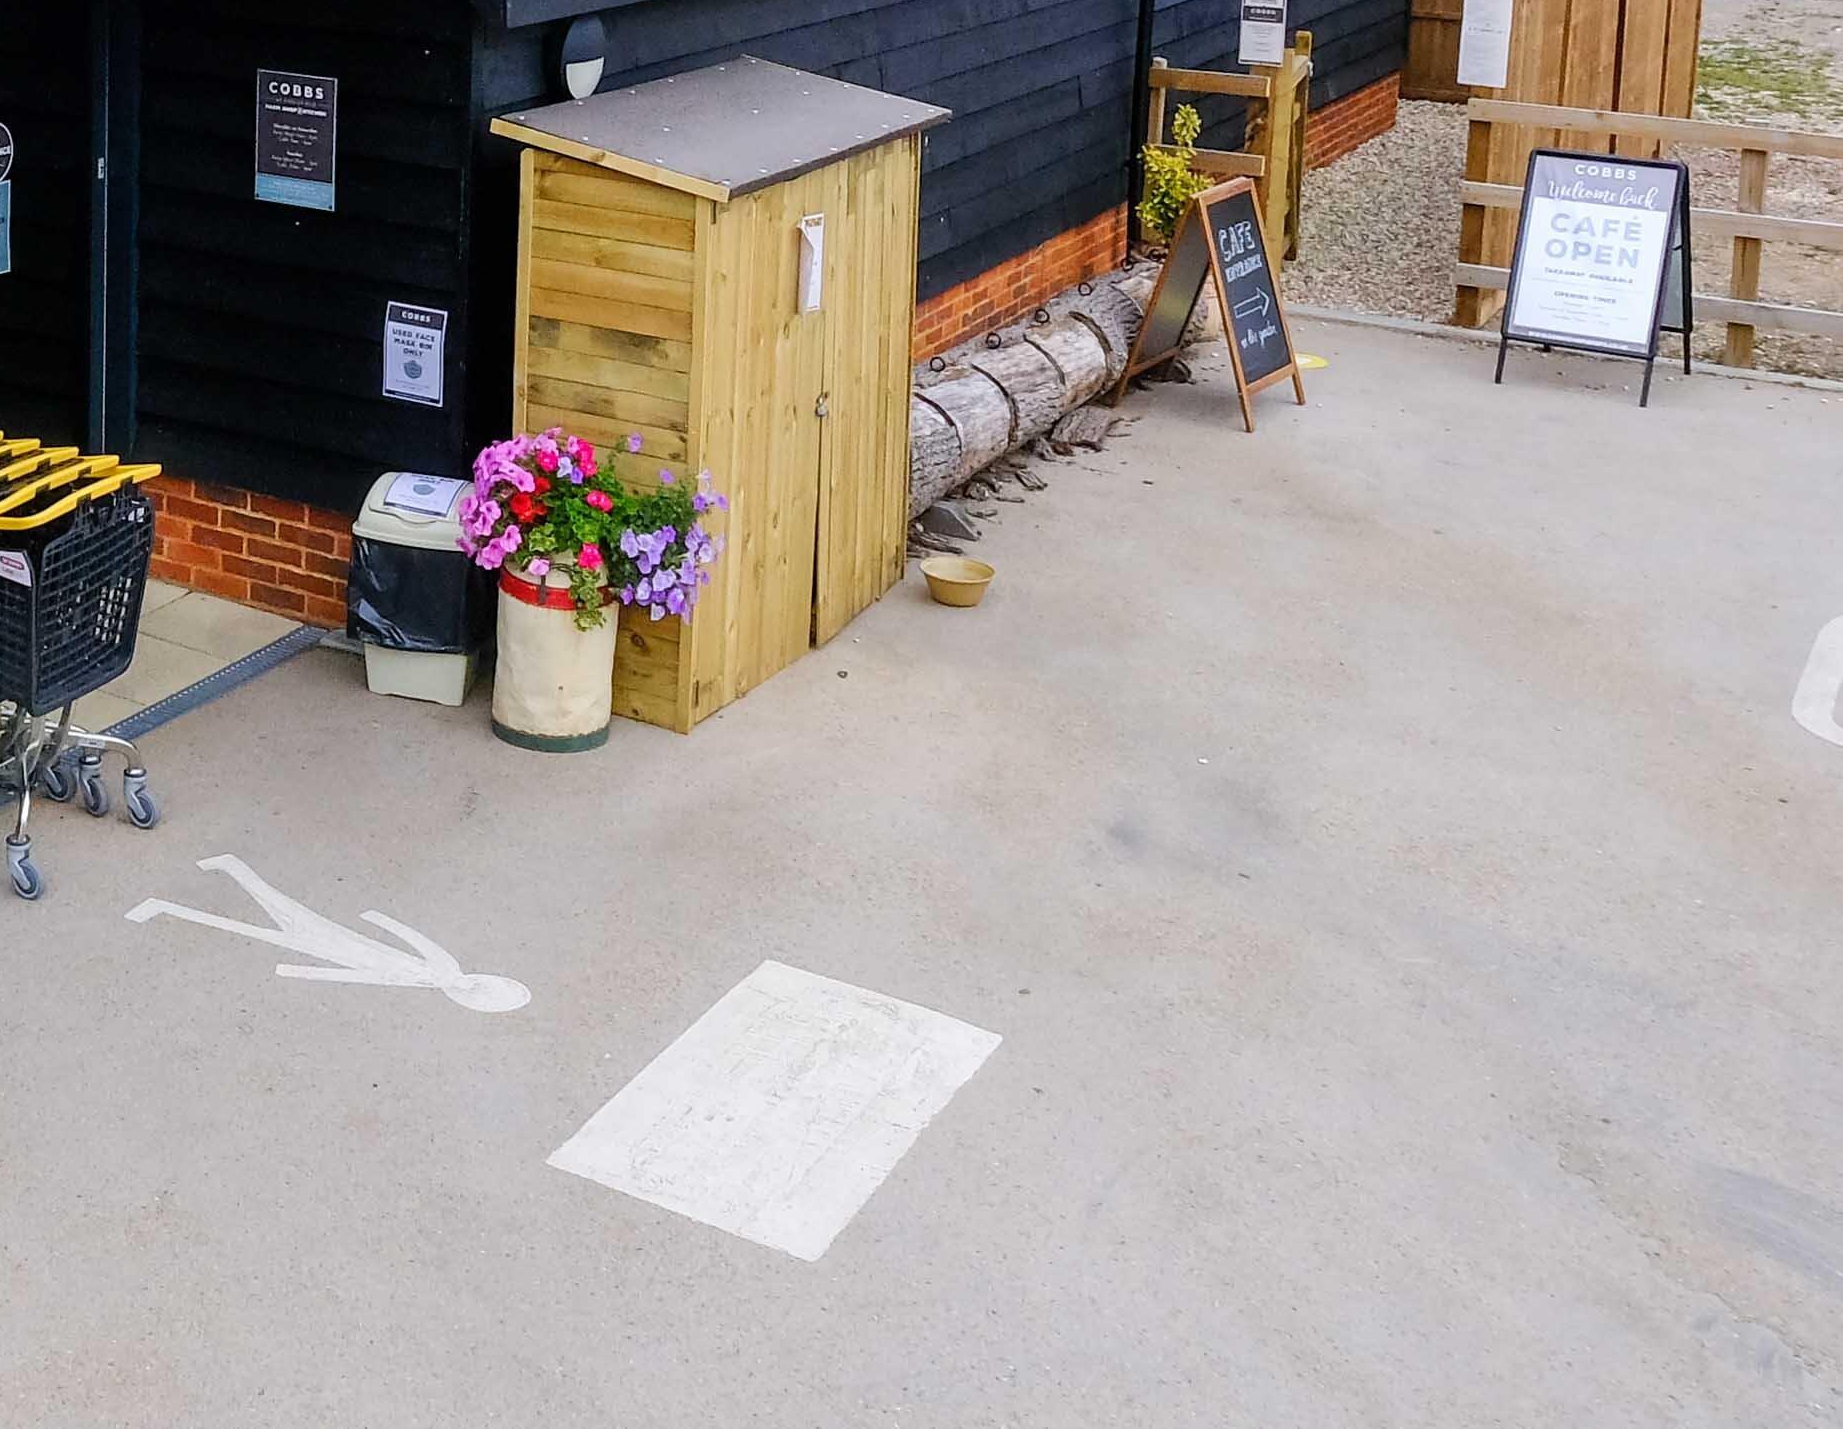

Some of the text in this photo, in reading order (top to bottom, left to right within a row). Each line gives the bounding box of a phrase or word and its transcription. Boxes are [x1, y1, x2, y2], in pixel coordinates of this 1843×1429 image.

[268, 82, 324, 100] COBBS
[1574, 164, 1637, 181] COBBS
[1548, 180, 1659, 210] Welcome back
[1218, 221, 1256, 263] CAFE
[1550, 212, 1643, 242] CAFÉ
[1544, 238, 1640, 268] OPEN
[401, 311, 431, 323] COBBS
